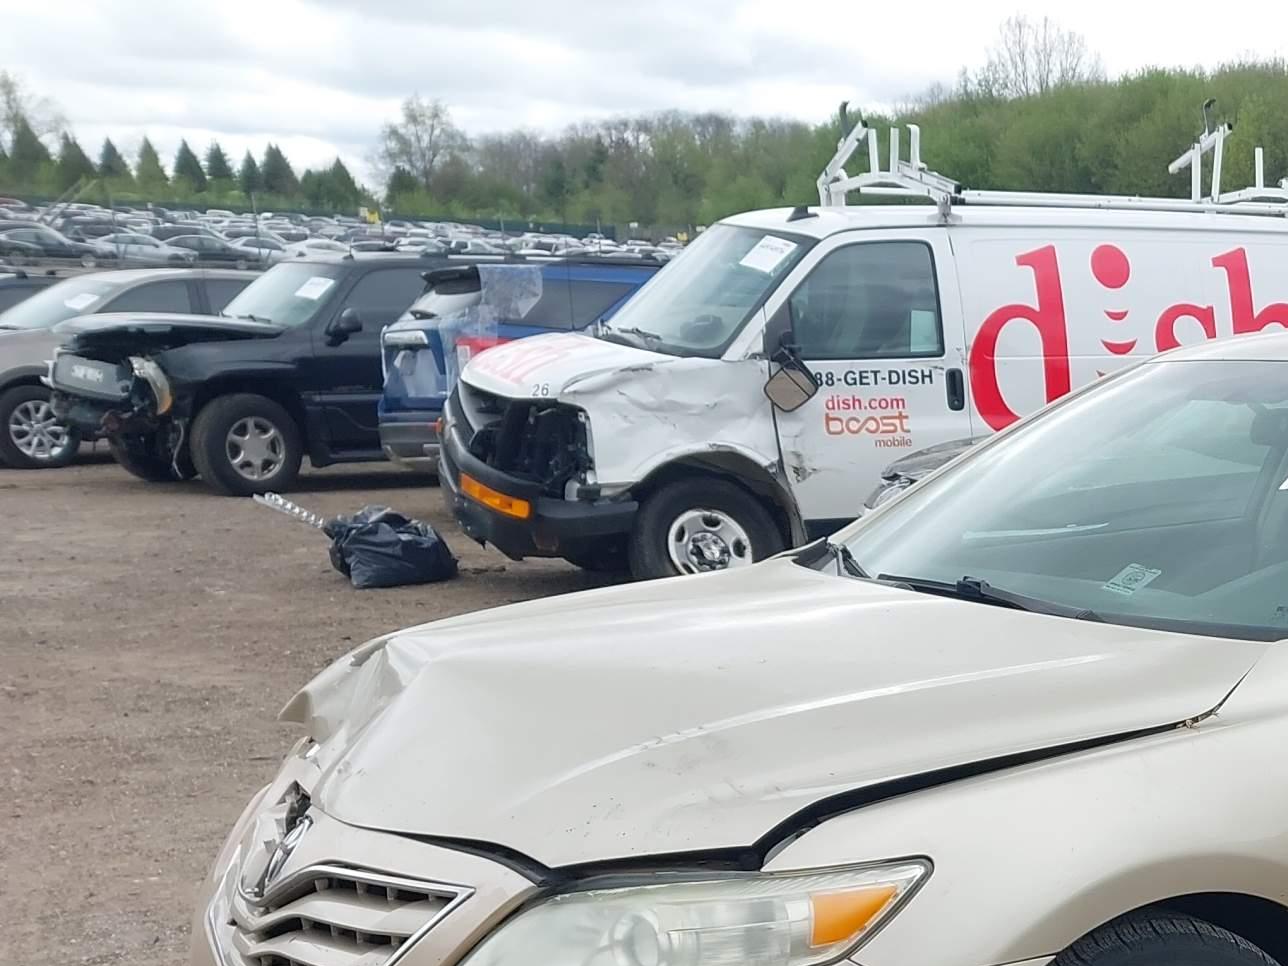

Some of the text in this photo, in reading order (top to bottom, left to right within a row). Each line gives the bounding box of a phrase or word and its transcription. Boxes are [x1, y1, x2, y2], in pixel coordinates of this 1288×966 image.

[532, 383, 549, 397] 26
[825, 395, 906, 411] dish.com
[825, 411, 911, 435] boost
[875, 436, 913, 449] mobile
